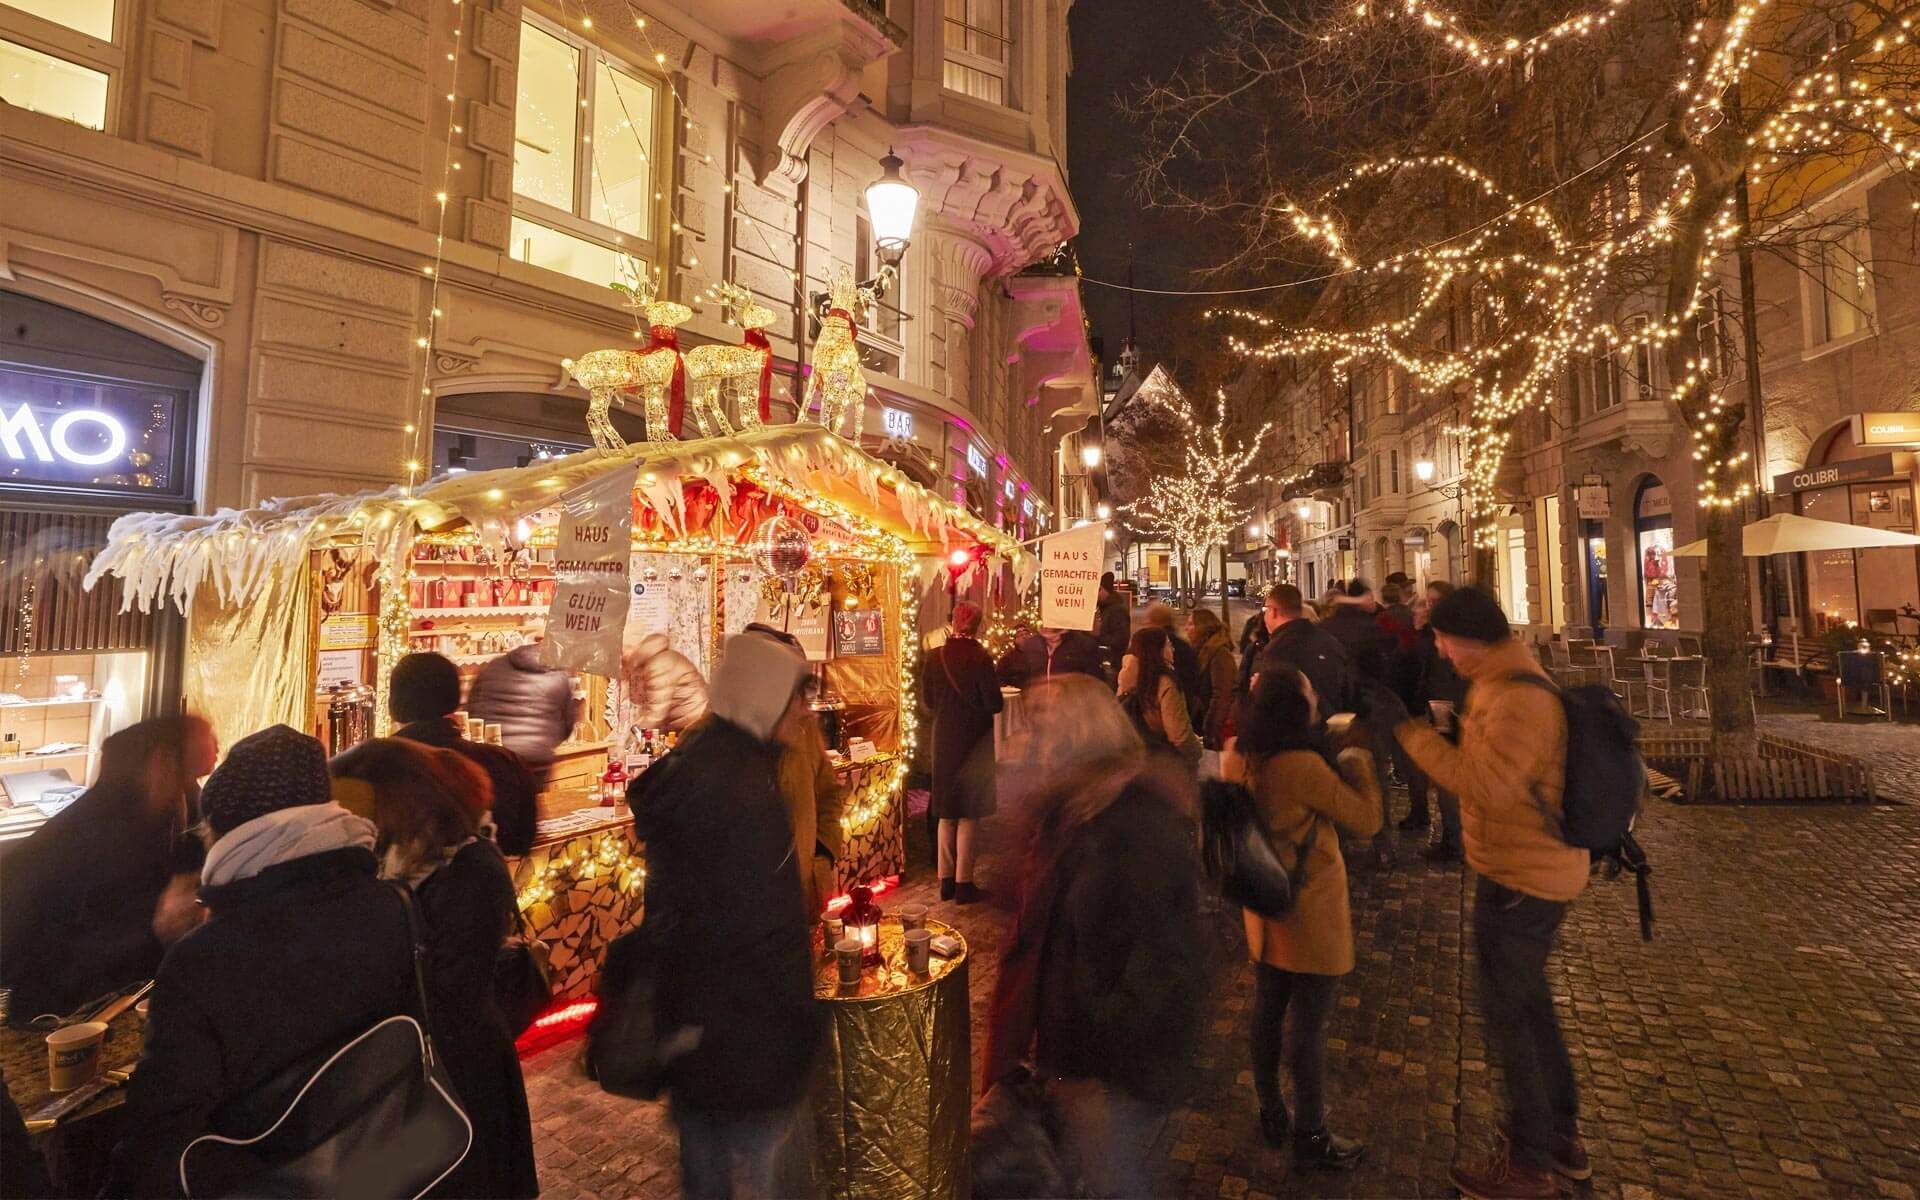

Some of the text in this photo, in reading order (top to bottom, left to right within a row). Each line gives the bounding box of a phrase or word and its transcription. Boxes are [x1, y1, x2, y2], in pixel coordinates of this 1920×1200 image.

[888, 412, 911, 433] BAR
[1793, 468, 1839, 488] COLIBRI
[806, 515, 816, 529] PH
[575, 526, 609, 543] HAUS
[1053, 551, 1088, 561] HAUS
[557, 560, 623, 573] GEMACHTER
[1043, 569, 1098, 581] GEMACHTER
[1057, 583, 1083, 596] GLÜH
[569, 591, 606, 612] GLÜH
[565, 613, 600, 632] WEIN
